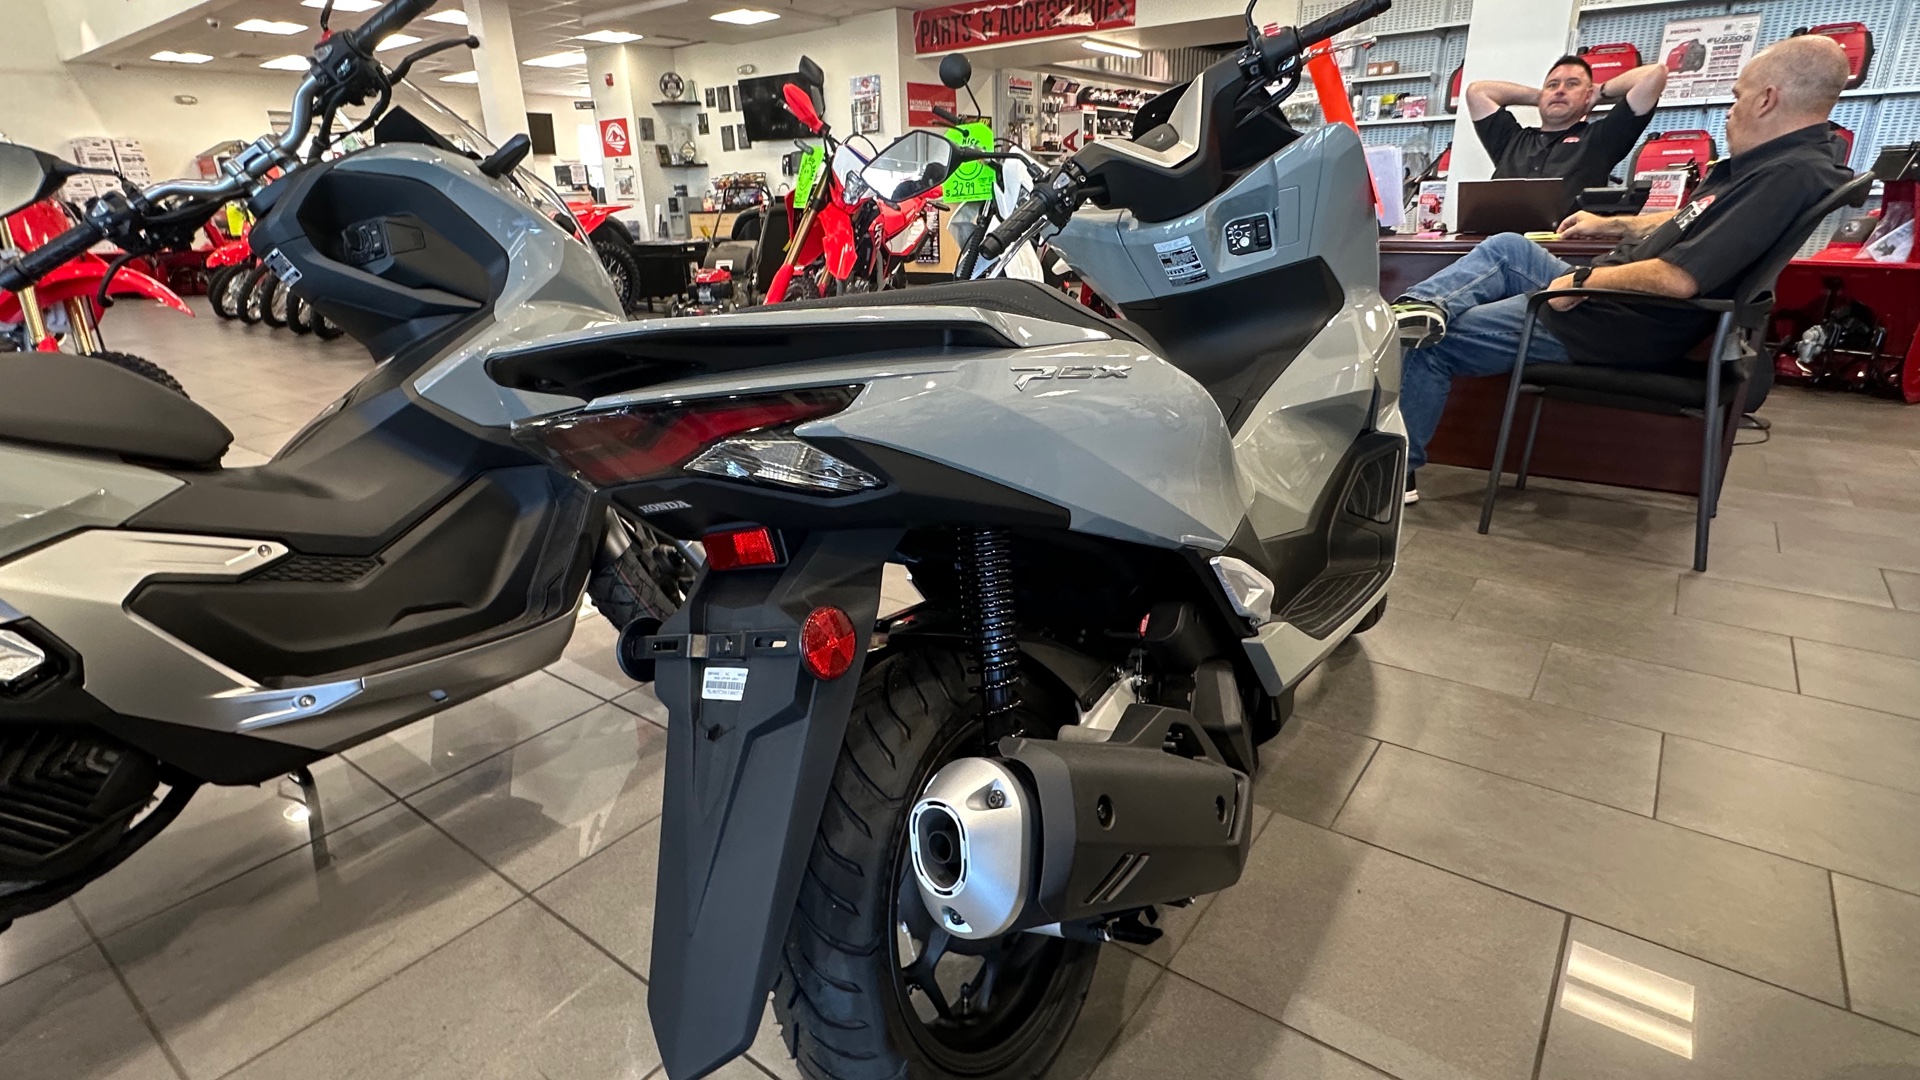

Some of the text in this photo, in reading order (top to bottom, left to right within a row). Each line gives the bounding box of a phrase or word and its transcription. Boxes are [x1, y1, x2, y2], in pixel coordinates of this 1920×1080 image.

[920, 0, 1129, 48] PARTS & ACCESSORIES
[1652, 181, 1671, 189] OLD
[1009, 365, 1132, 392] PCX
[639, 500, 692, 513] HONDA
